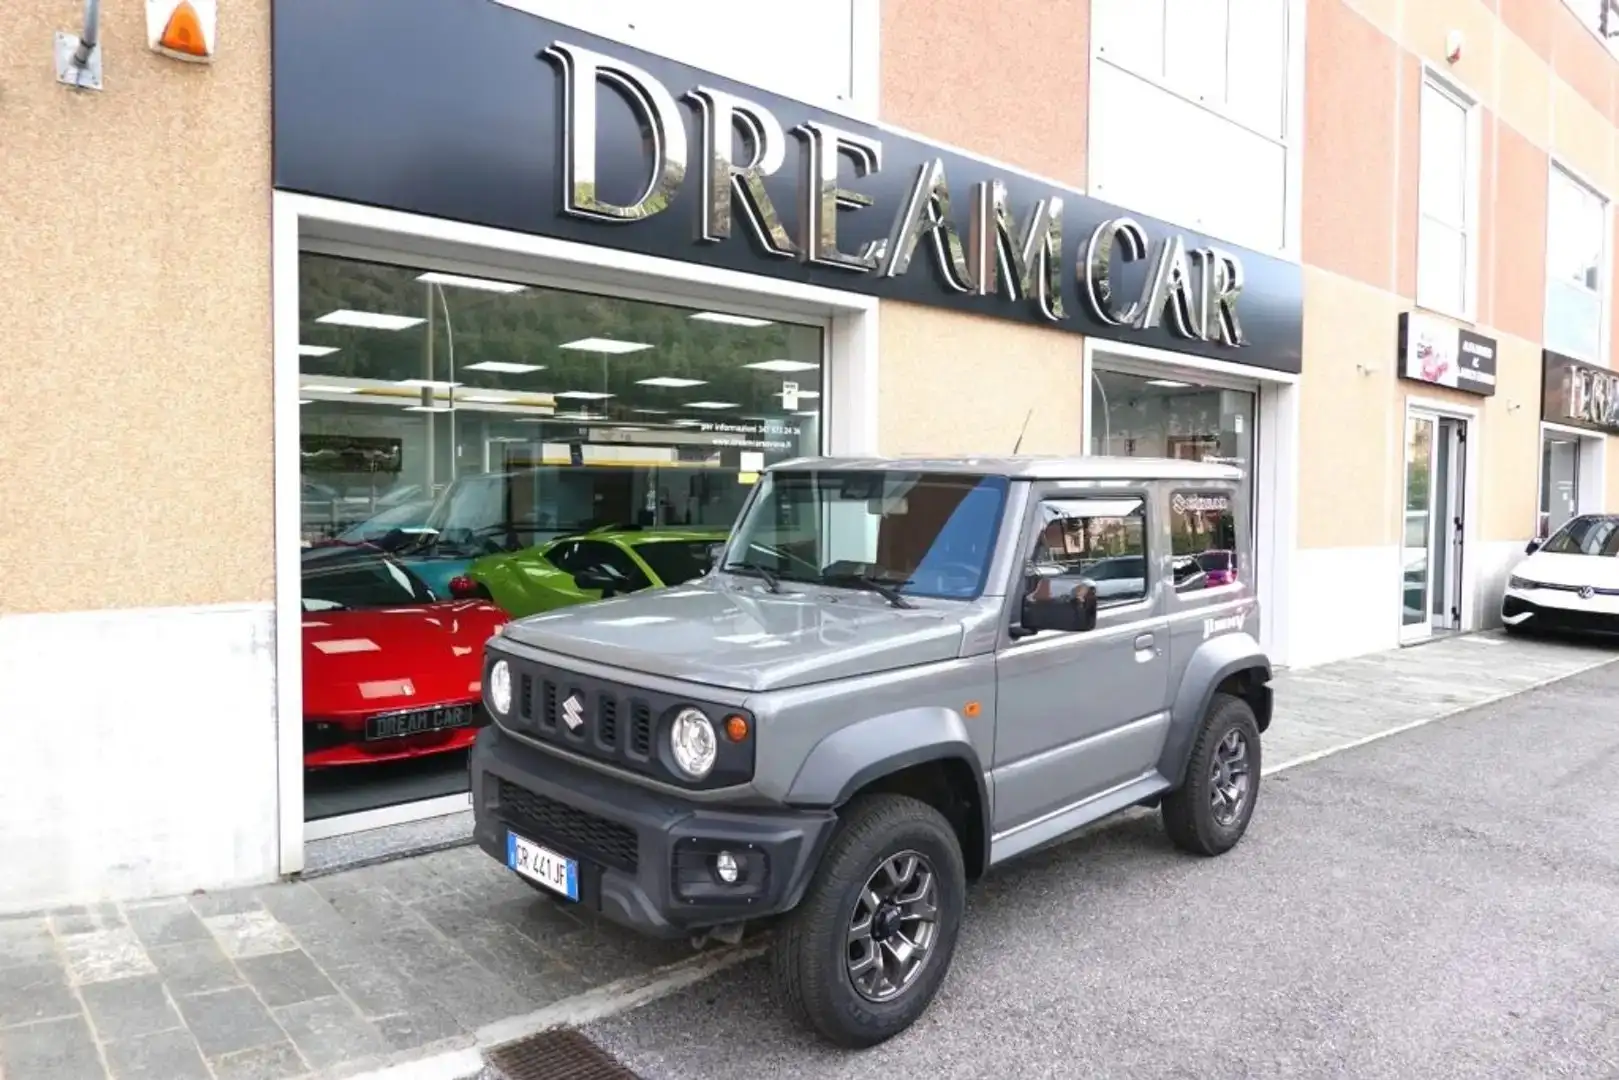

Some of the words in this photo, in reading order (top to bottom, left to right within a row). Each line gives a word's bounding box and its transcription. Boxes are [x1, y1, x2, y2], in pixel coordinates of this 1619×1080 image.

[536, 40, 1071, 322] DREAM
[1075, 214, 1249, 348] CAR
[433, 705, 463, 727] CAR
[532, 852, 552, 881] 441
[553, 861, 567, 887] JF
